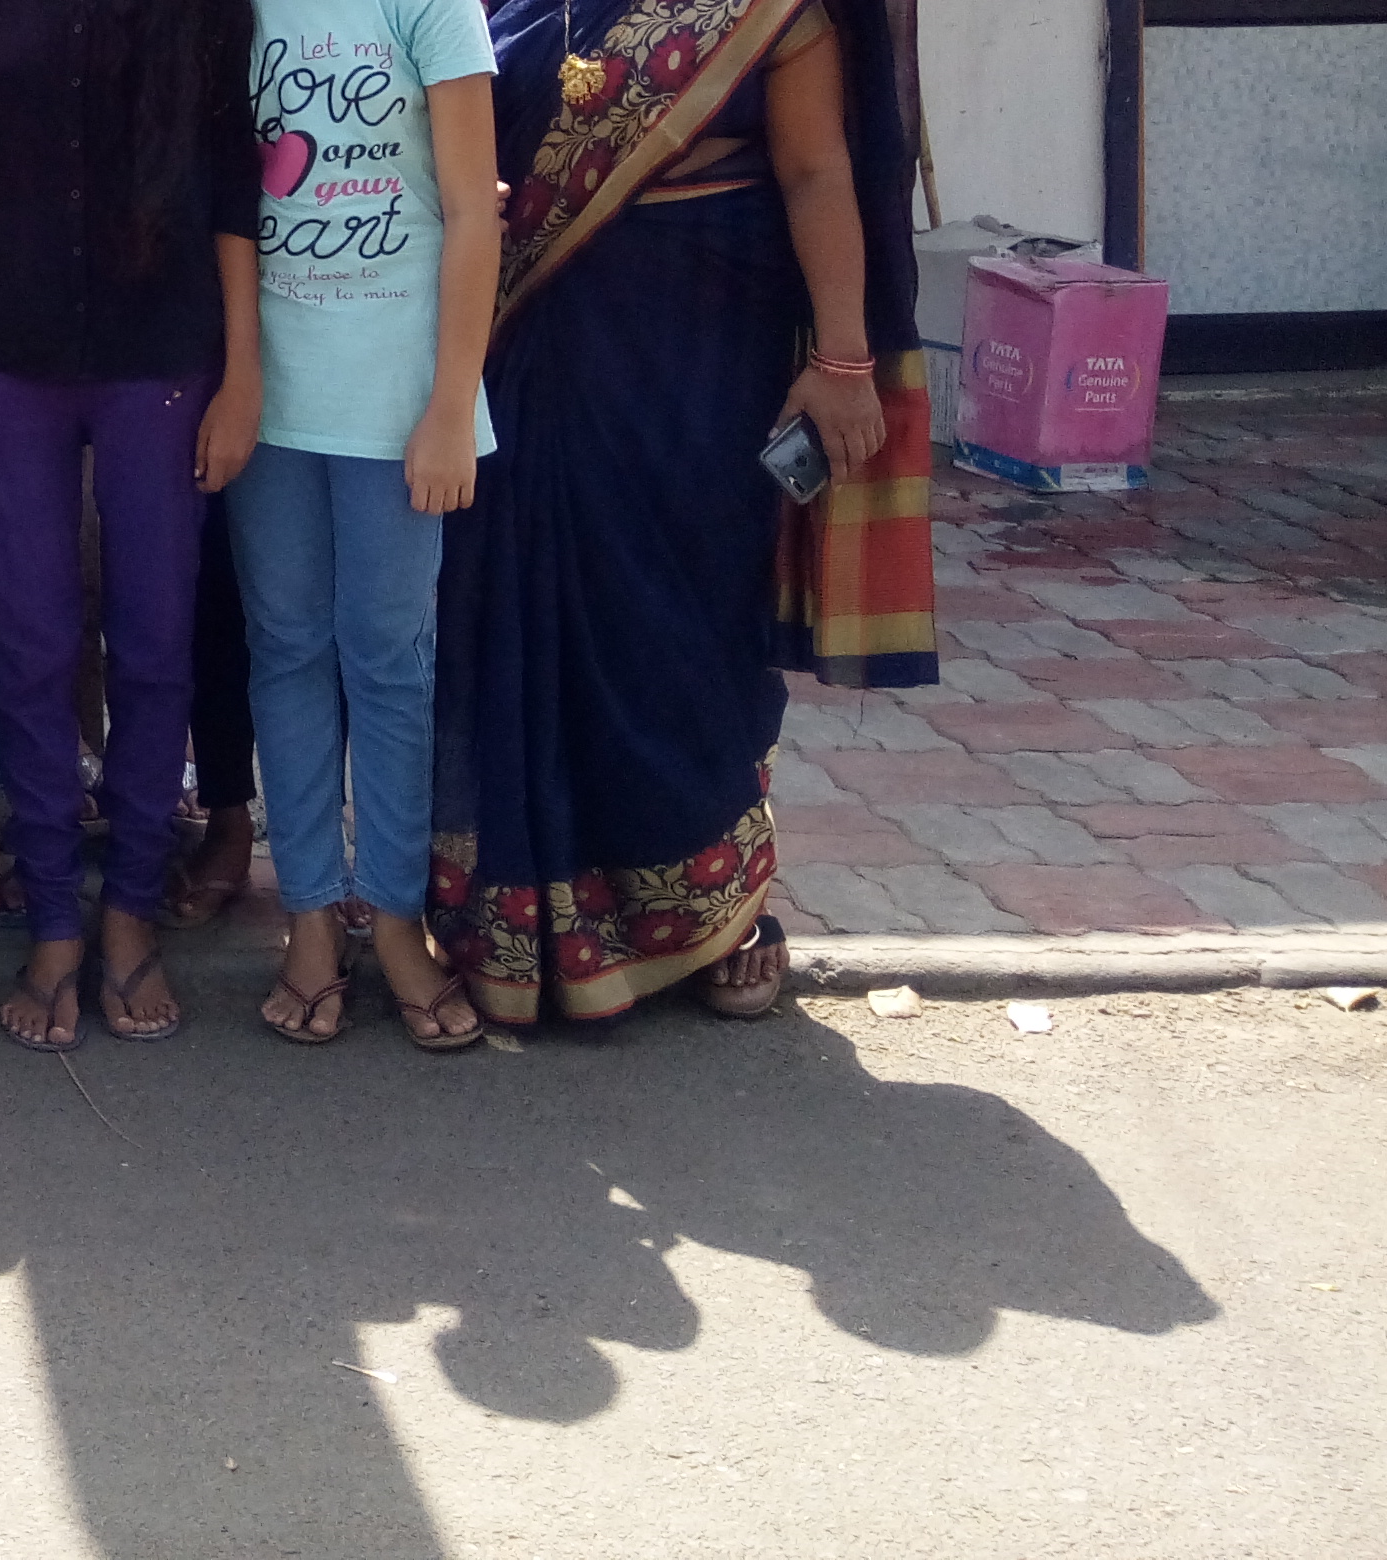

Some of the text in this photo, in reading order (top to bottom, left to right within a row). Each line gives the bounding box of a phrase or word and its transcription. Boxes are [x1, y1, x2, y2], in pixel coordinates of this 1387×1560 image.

[300, 32, 393, 69] Let my
[322, 140, 402, 169] open
[314, 175, 404, 206] your
[256, 194, 409, 259] eart
[989, 340, 1021, 361] TATA
[1086, 357, 1125, 371] TATA
[1078, 374, 1129, 387] Genuine
[1085, 391, 1117, 404] Parts
